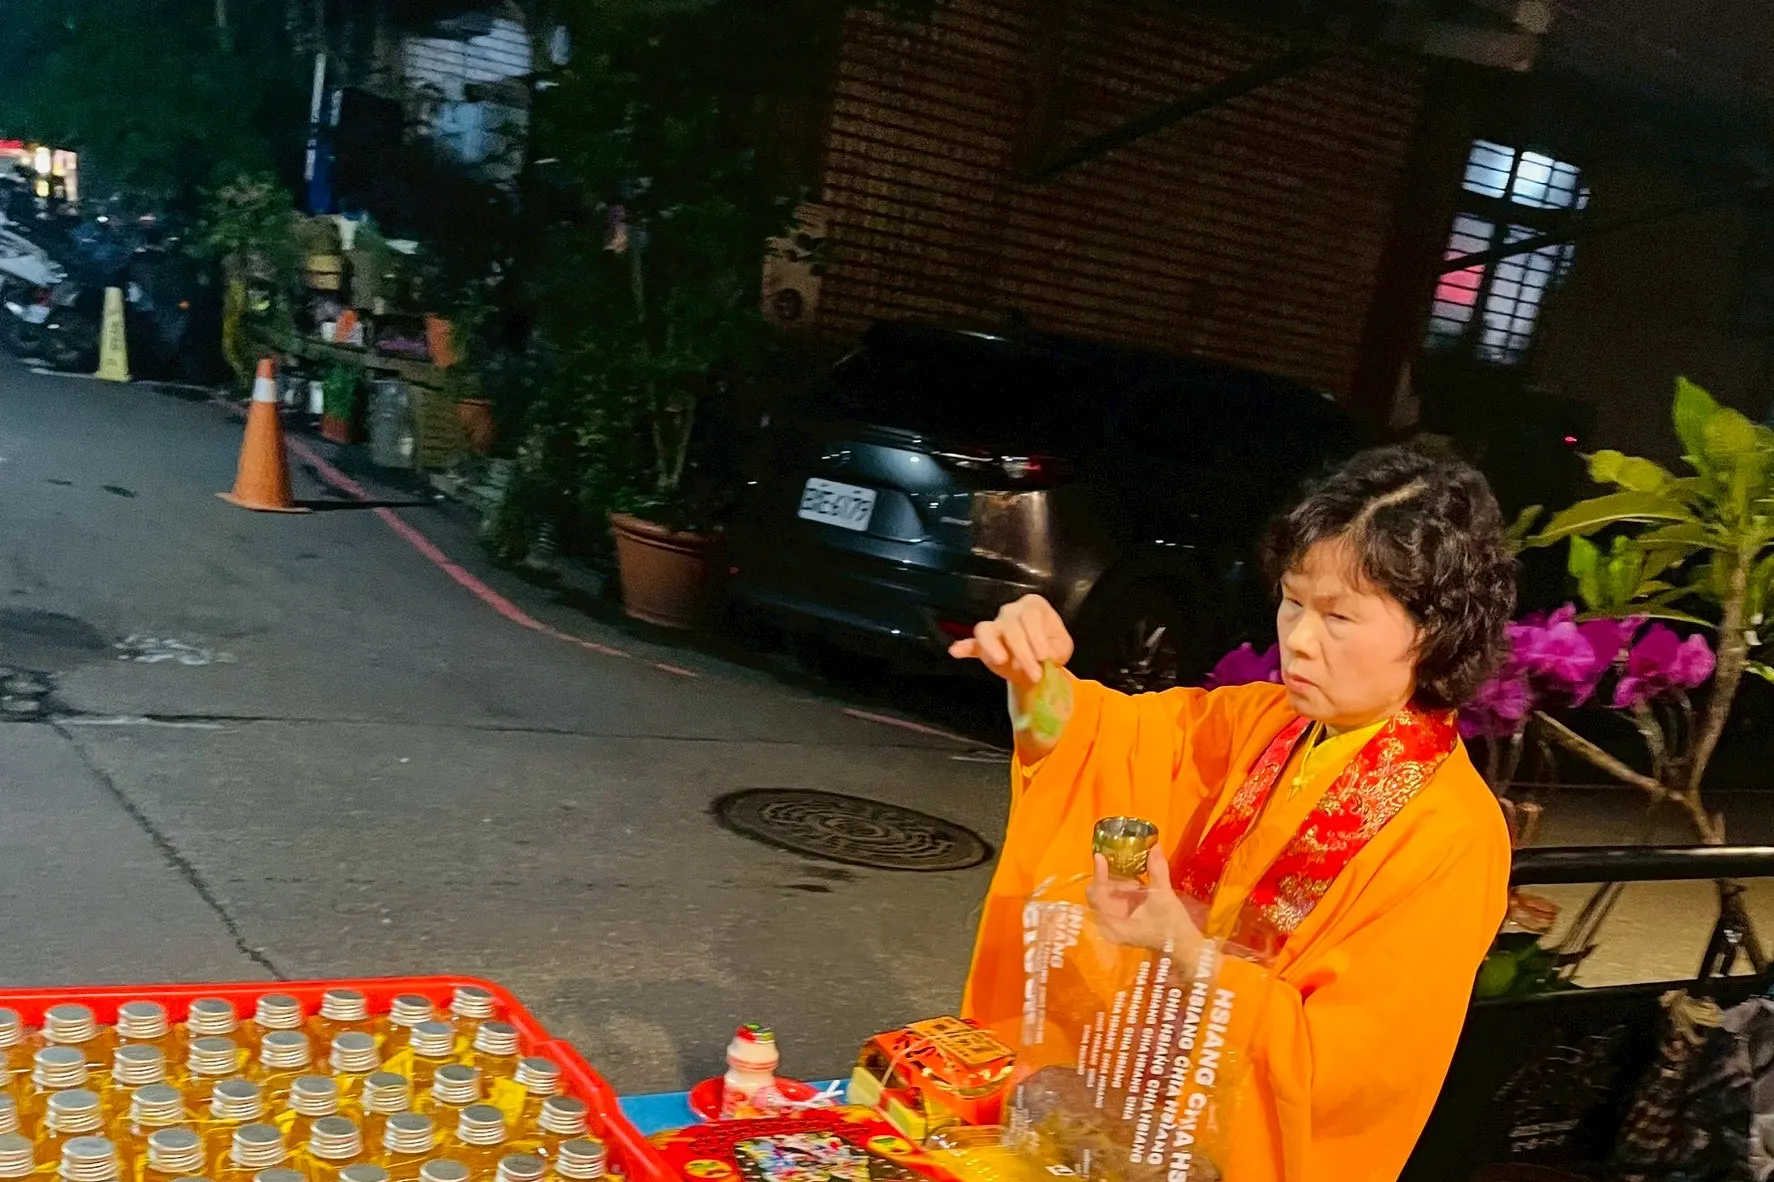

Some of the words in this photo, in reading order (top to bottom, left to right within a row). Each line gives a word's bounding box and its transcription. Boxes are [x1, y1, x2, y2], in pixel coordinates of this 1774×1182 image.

[1135, 961, 1151, 985] CHIA
[1154, 957, 1171, 983] CHIA
[1126, 986, 1145, 1024] HSIANG
[1145, 983, 1164, 1025] HSIANG
[1162, 987, 1182, 1023] CHIA
[1178, 982, 1209, 1050] HSIANG
[1119, 1027, 1134, 1051] CHIA
[1139, 1027, 1154, 1053] CHIA
[1150, 1023, 1175, 1075] HSIANG
[1195, 988, 1235, 1086] HSIANG
[1111, 1051, 1129, 1089] HSIANG
[1128, 1053, 1149, 1093] HSIANG
[1165, 1055, 1191, 1097] CHIA
[1122, 1096, 1137, 1120] CHIA
[1140, 1079, 1161, 1111] CHIA
[1129, 1112, 1152, 1164] HSIANG
[1147, 1099, 1180, 1164] HSIANG
[1172, 1092, 1208, 1148] CHIA
